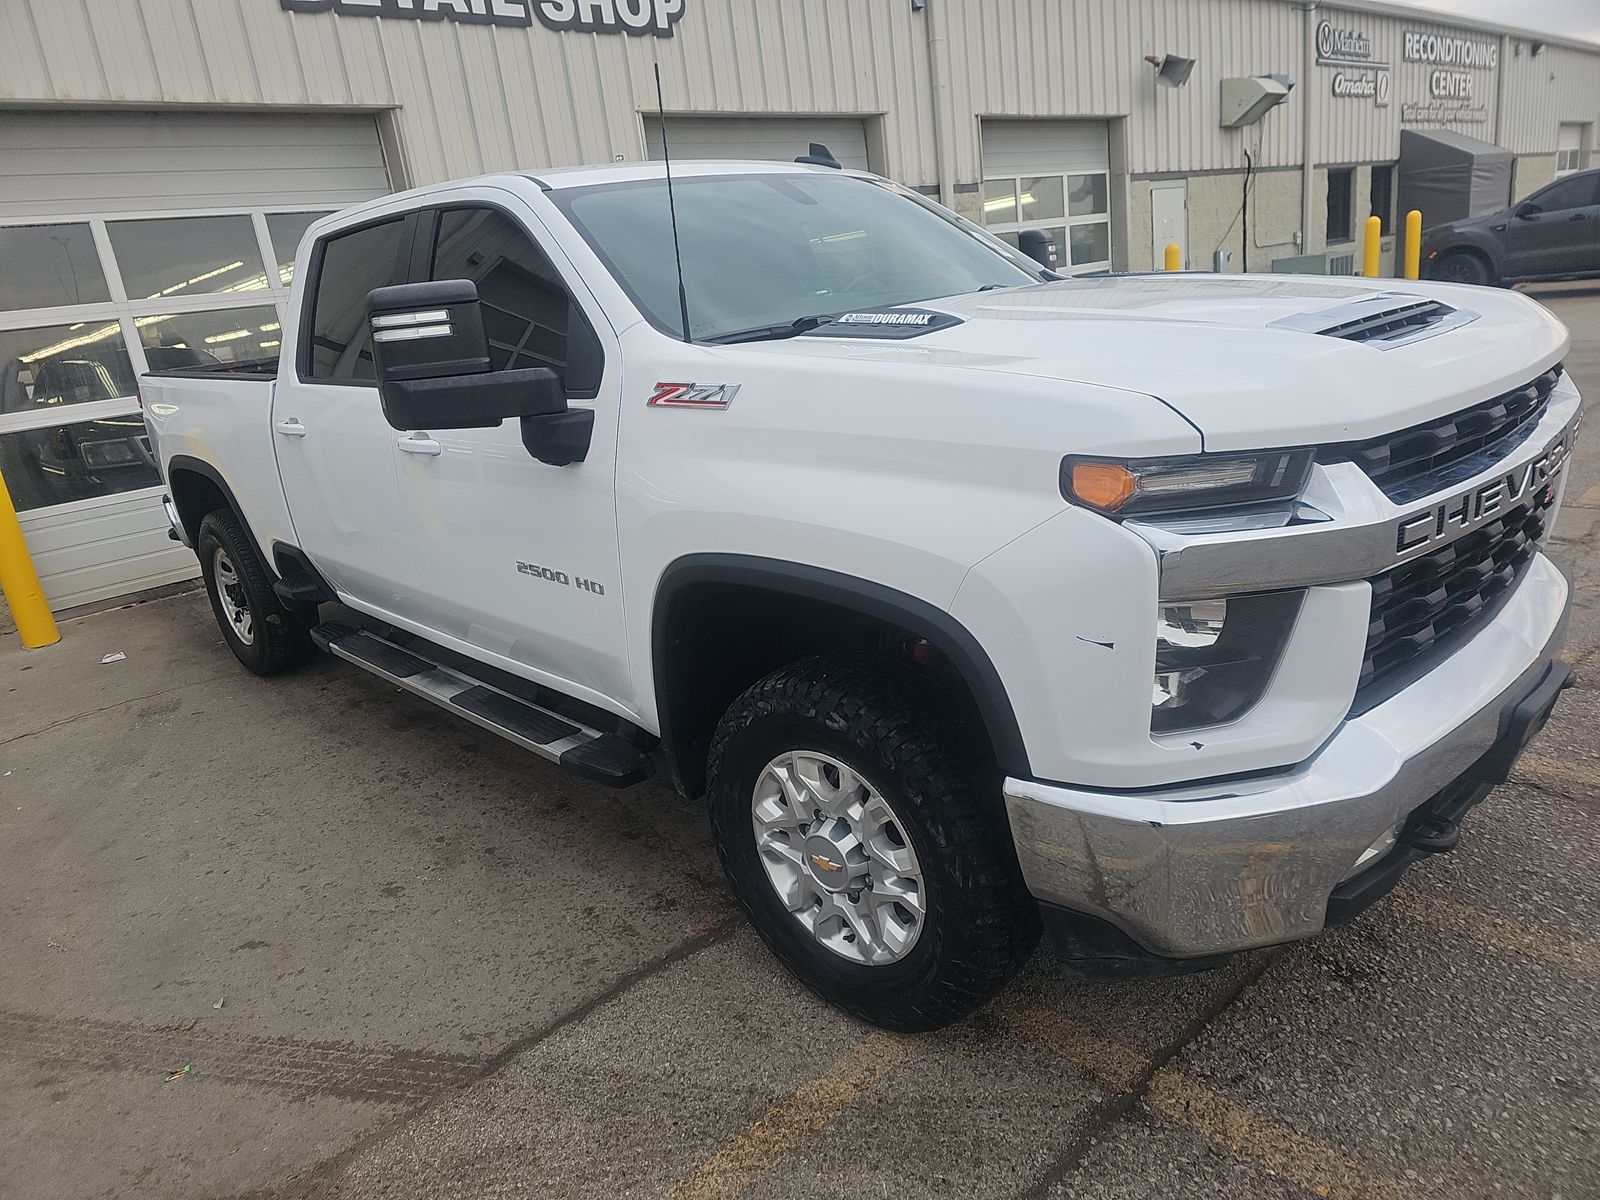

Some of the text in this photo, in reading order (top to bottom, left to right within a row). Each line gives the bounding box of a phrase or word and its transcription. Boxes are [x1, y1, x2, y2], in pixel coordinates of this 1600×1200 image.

[540, 0, 683, 29] SHOP
[1334, 31, 1370, 54] Manheim
[1405, 33, 1496, 67] RECONDITIONING
[1334, 74, 1376, 94] Omaha
[1432, 71, 1472, 97] CENTER
[873, 314, 932, 325] DURAMAX
[646, 382, 742, 411] Z71
[515, 559, 605, 596] 2500 HD
